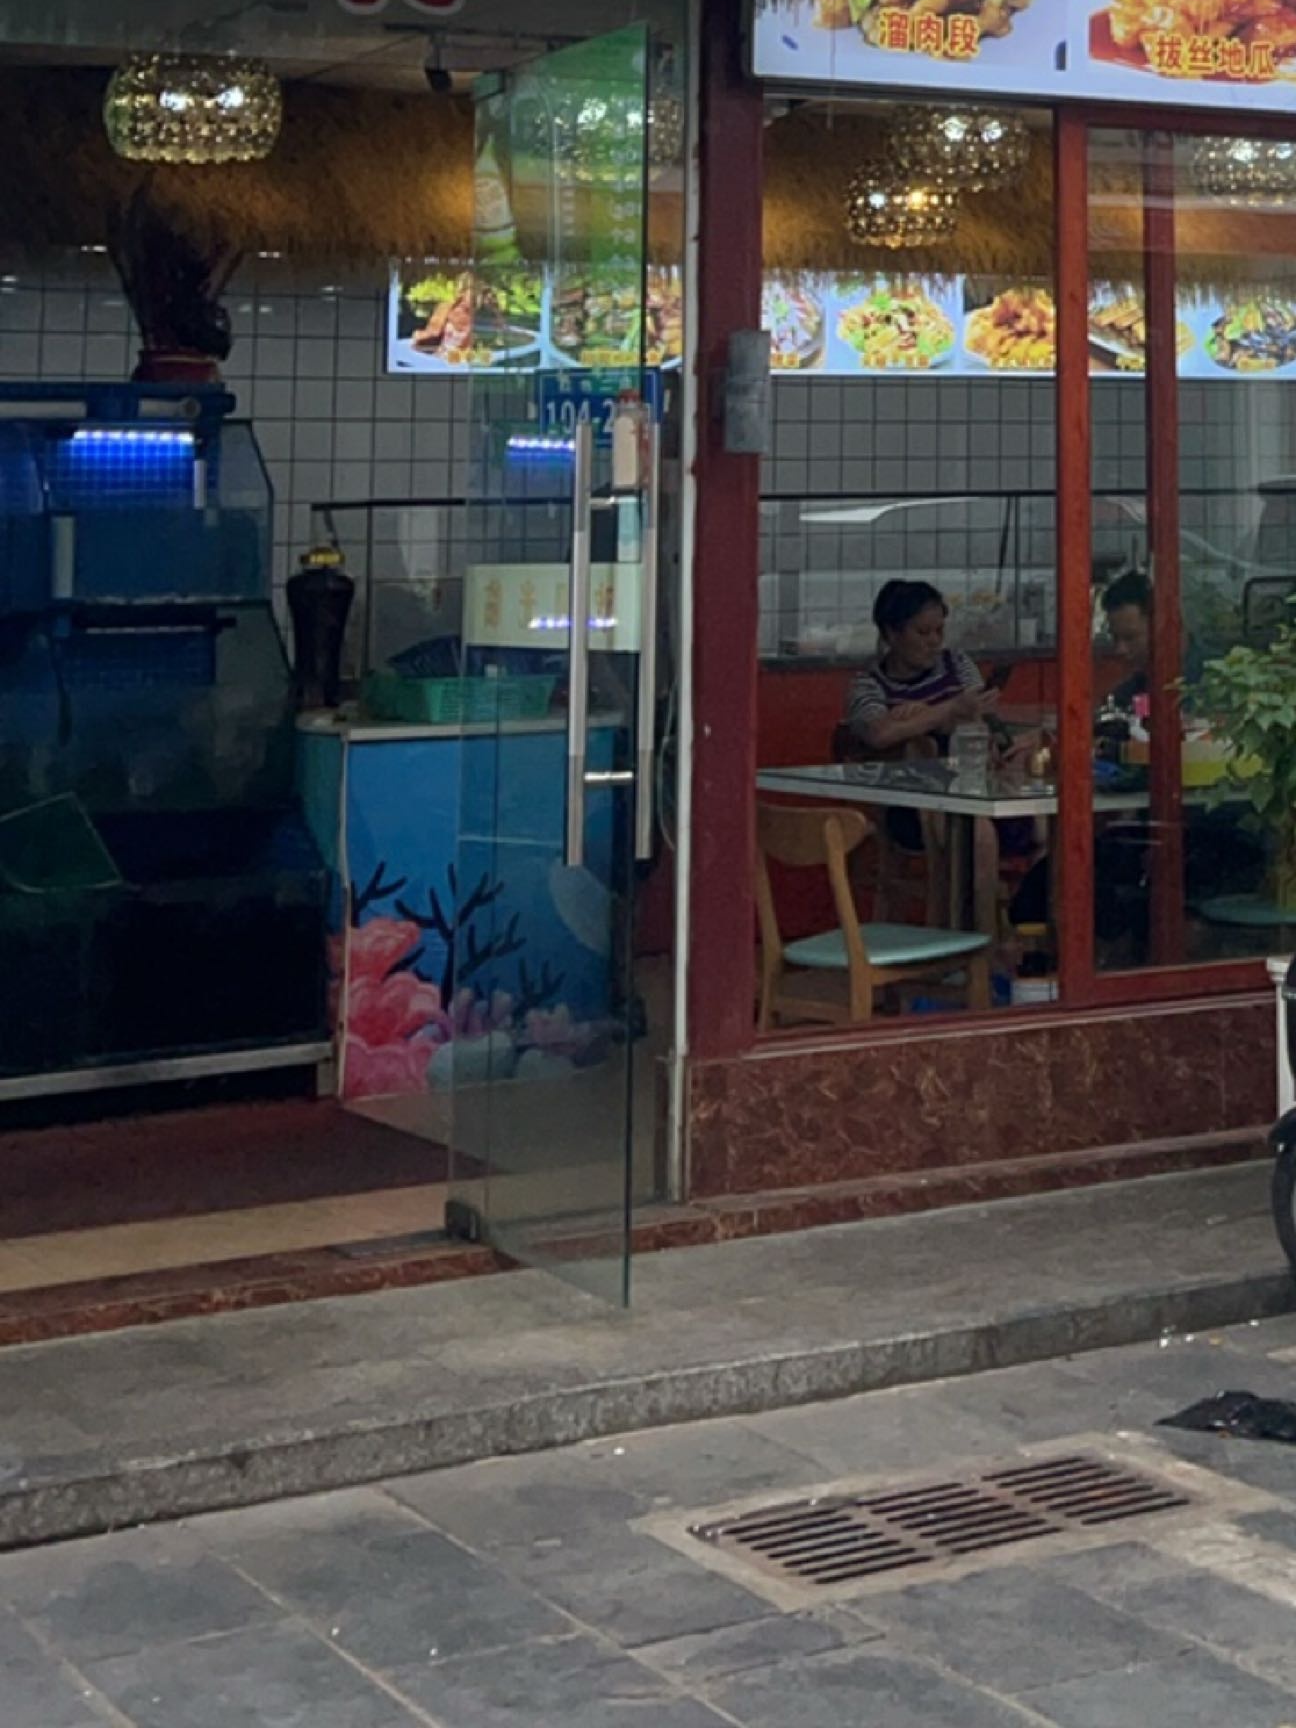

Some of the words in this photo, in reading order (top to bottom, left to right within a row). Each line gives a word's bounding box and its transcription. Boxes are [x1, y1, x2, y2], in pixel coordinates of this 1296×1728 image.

[879, 11, 980, 59] 溜肉段
[1152, 32, 1276, 78] 拔丝地瓜
